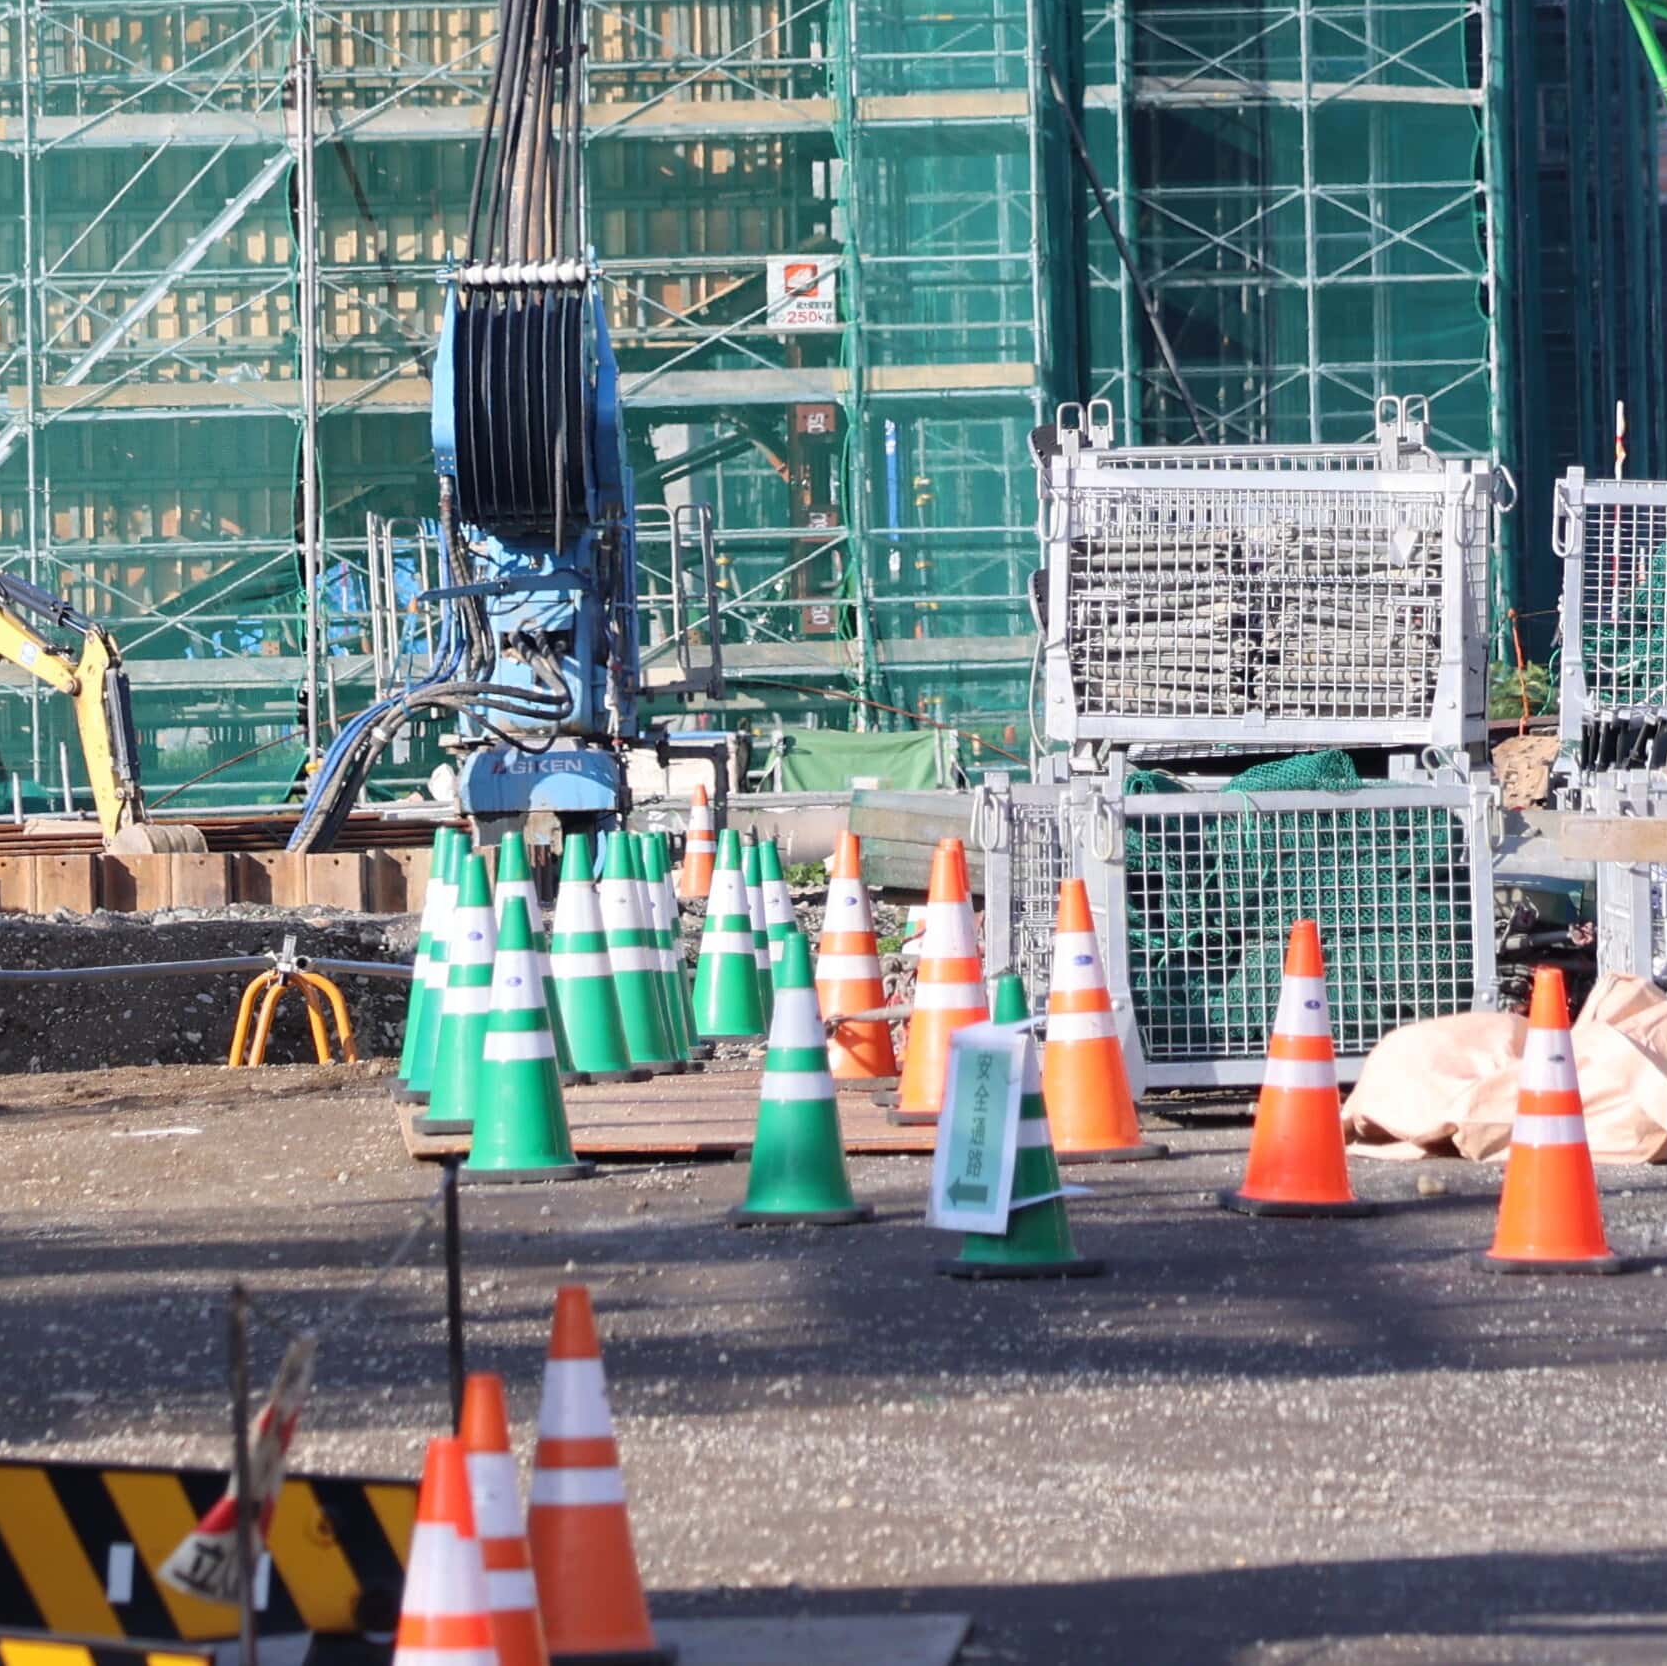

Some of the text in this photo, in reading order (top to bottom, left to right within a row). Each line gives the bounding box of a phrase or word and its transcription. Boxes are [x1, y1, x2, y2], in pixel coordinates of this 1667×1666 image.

[509, 759, 583, 775] GIKEN
[965, 1053, 993, 1178] 安全通路
